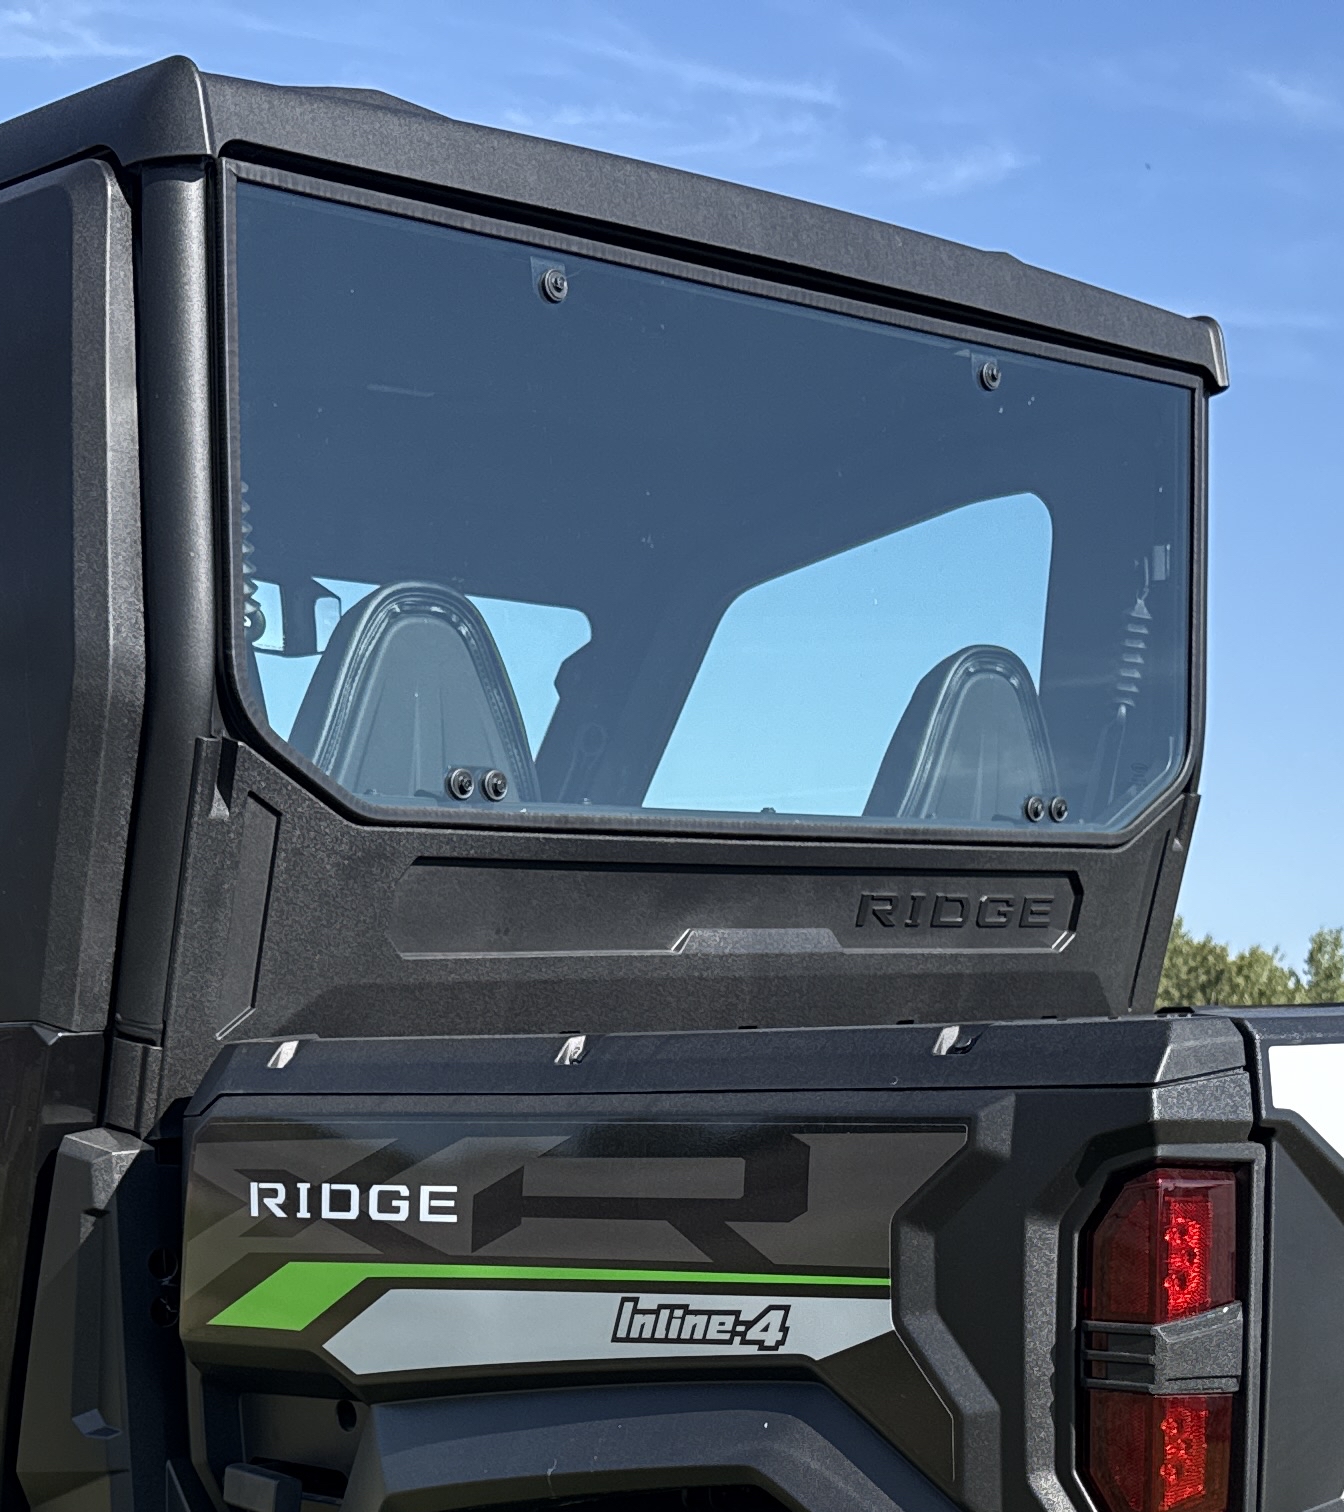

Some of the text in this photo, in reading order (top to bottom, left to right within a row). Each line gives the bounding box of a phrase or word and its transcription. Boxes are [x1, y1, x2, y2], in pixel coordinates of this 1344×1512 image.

[856, 892, 1055, 928] RIDGE
[249, 1181, 458, 1223] RIDGE
[610, 1296, 792, 1352] Inline-4
